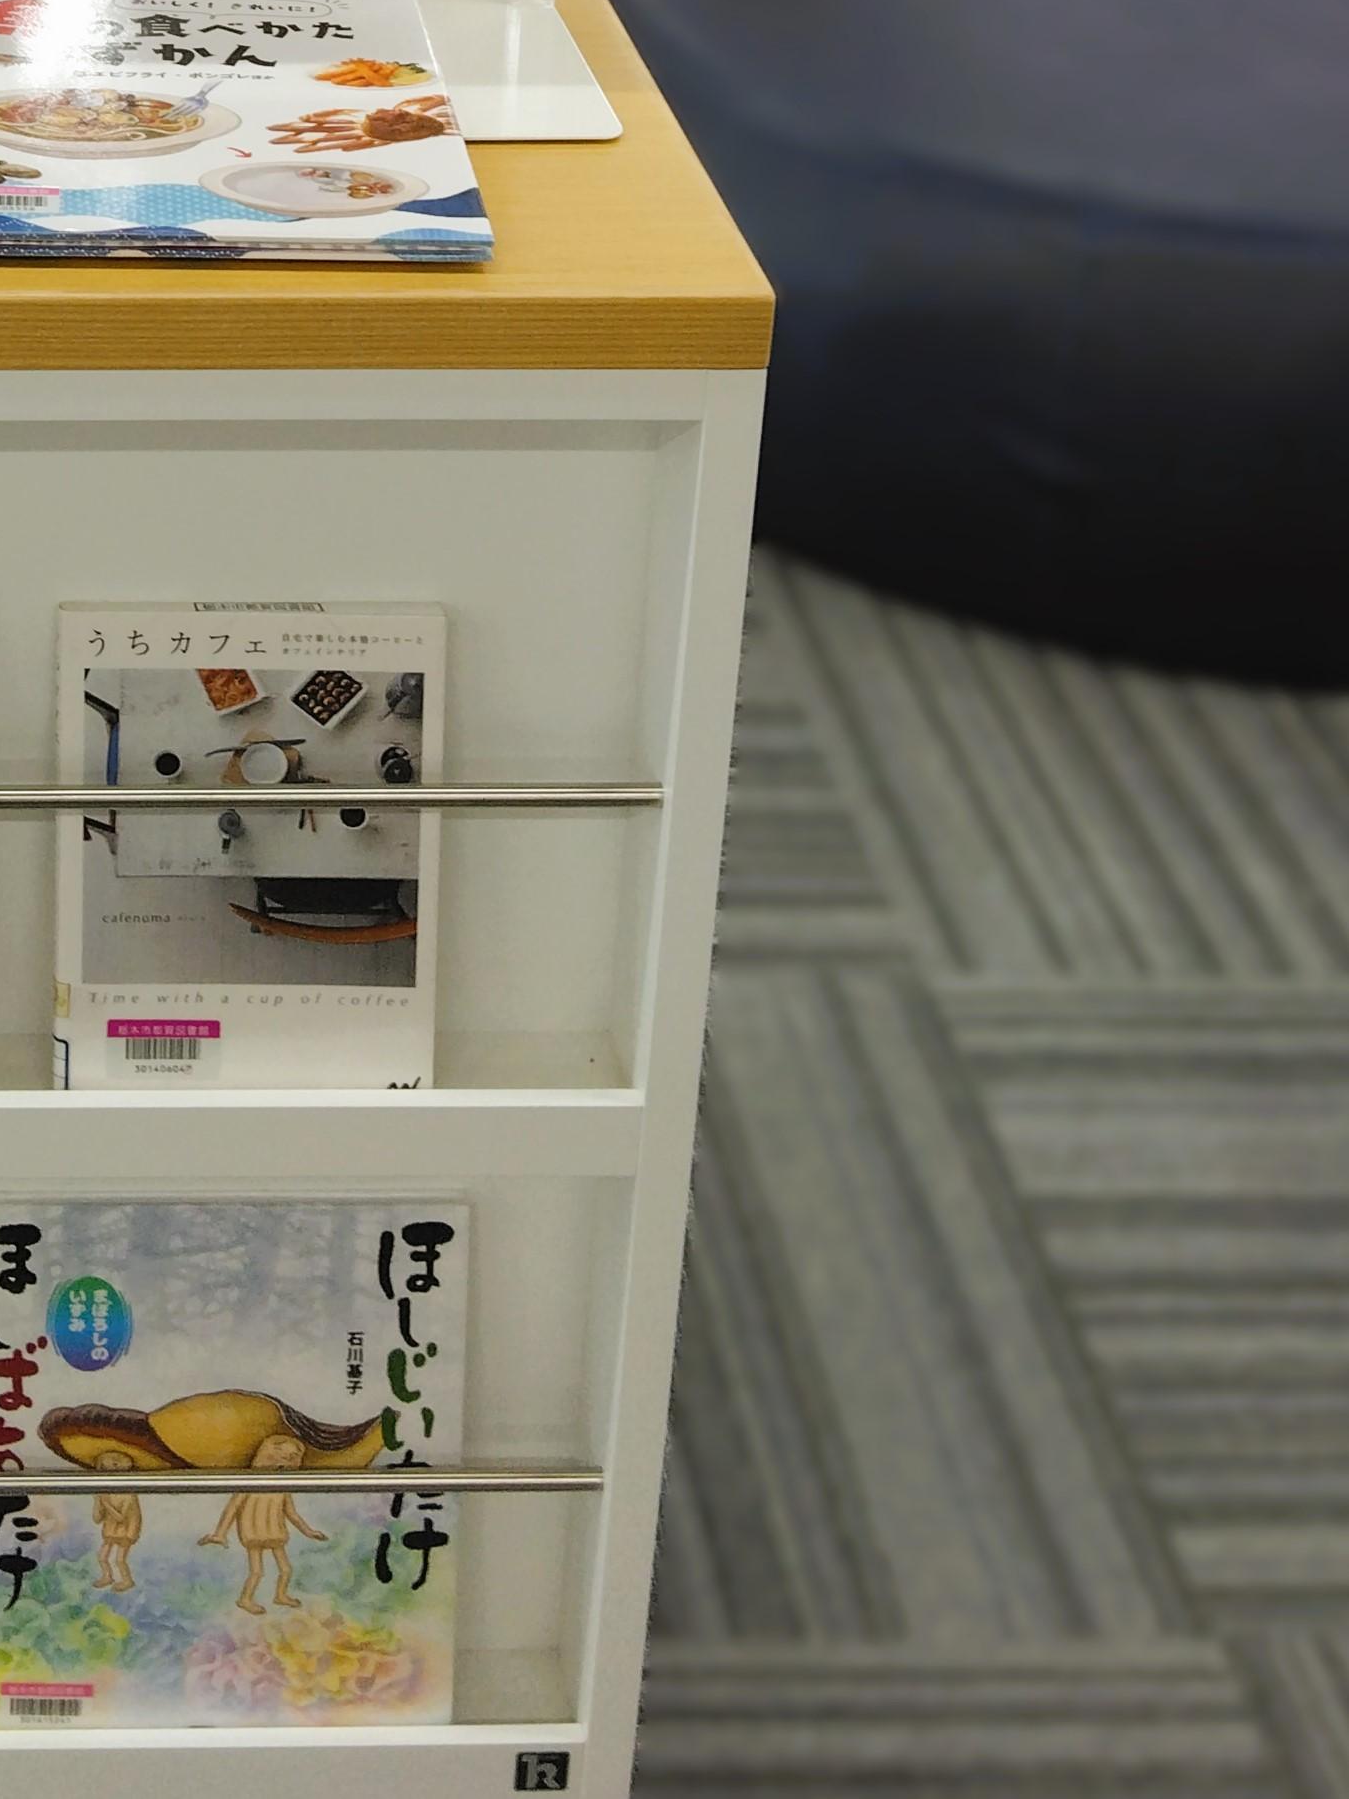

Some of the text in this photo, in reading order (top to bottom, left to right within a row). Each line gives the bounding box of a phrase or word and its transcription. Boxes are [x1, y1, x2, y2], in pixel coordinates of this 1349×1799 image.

[88, 629, 267, 657] うちカフェ
[88, 991, 140, 1004] Time
[157, 992, 204, 1004] with
[247, 994, 284, 1007] cup
[300, 992, 322, 1005] of
[338, 993, 410, 1007] coffee
